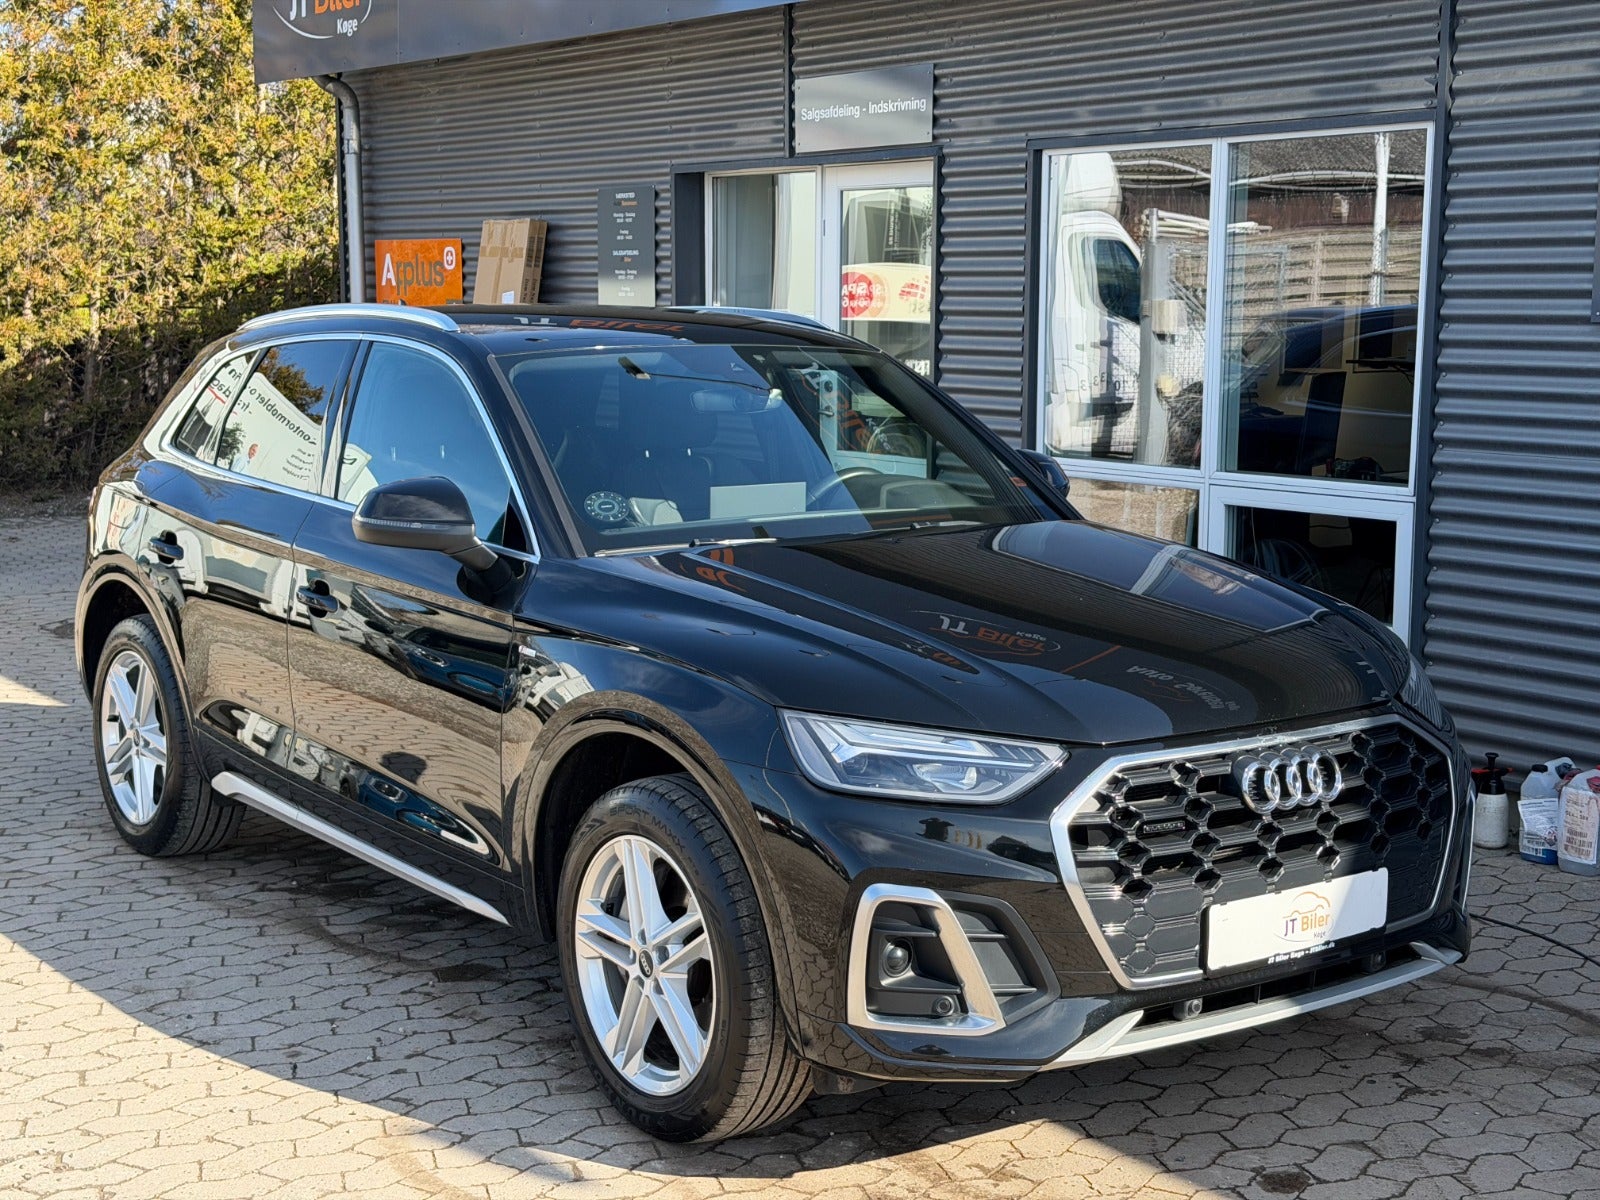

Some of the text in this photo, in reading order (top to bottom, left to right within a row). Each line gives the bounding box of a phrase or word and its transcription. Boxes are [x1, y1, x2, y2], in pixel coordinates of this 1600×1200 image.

[336, 18, 358, 37] Køge
[801, 105, 861, 122] Salgsafdeling
[868, 97, 927, 115] Indskrivning
[1284, 913, 1330, 937] JT Biler
